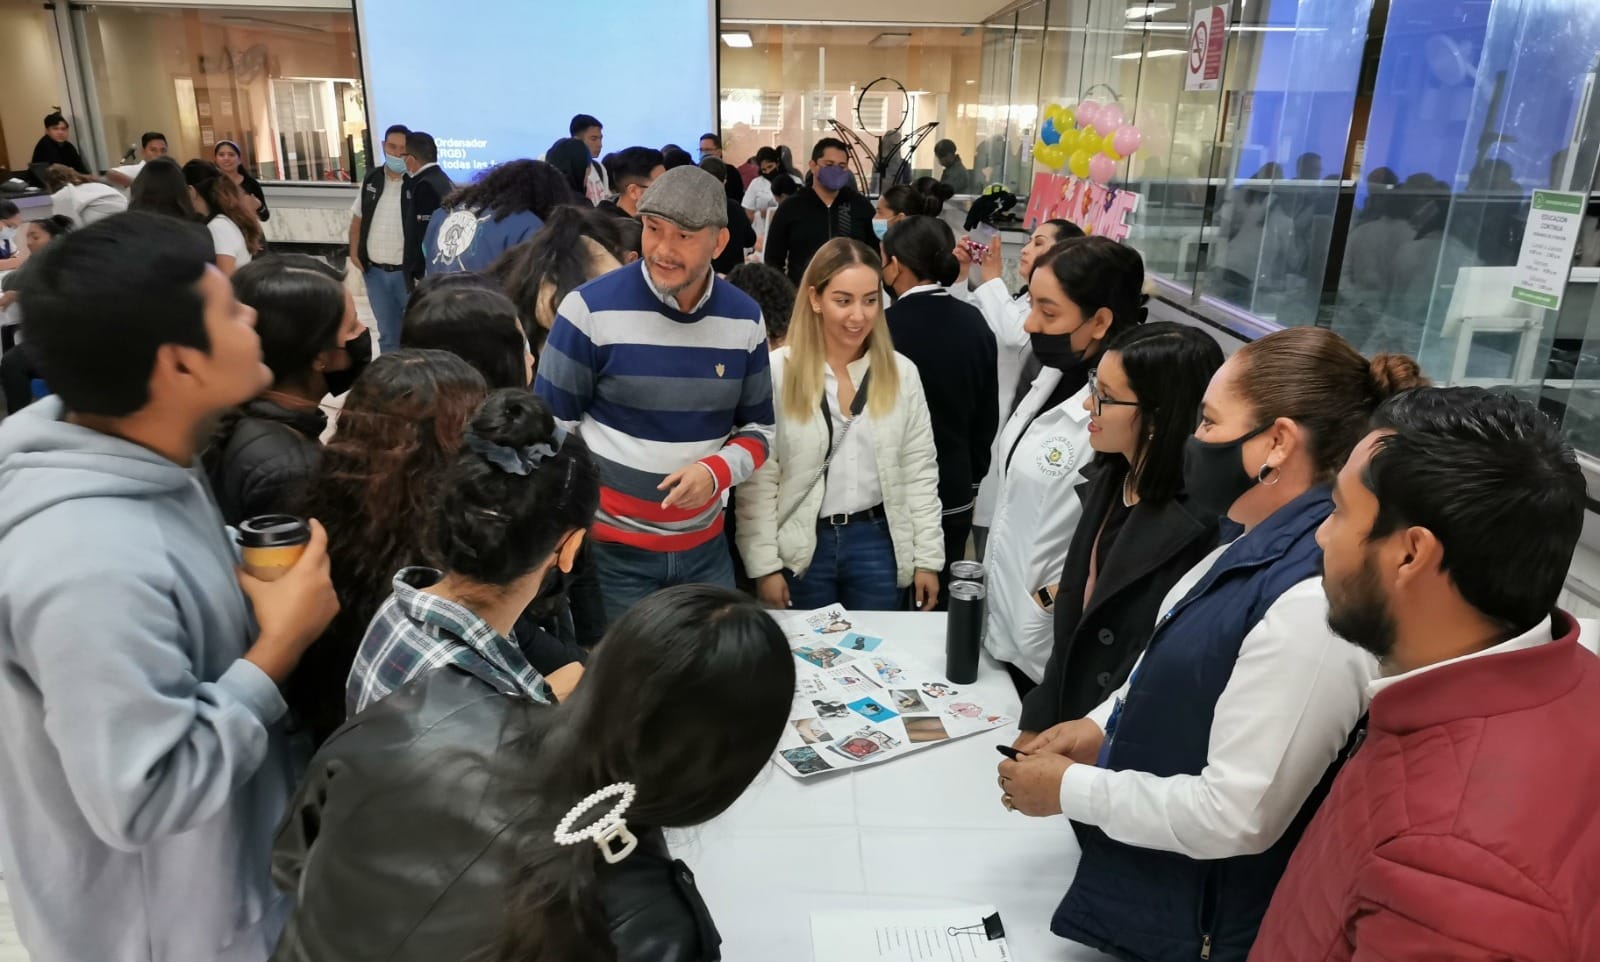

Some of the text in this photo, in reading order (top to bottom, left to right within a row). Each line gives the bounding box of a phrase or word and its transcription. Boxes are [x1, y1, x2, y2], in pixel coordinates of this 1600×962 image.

[435, 138, 487, 148] Ordenador
[437, 149, 467, 159] (RGB)
[442, 160, 471, 169] todas
